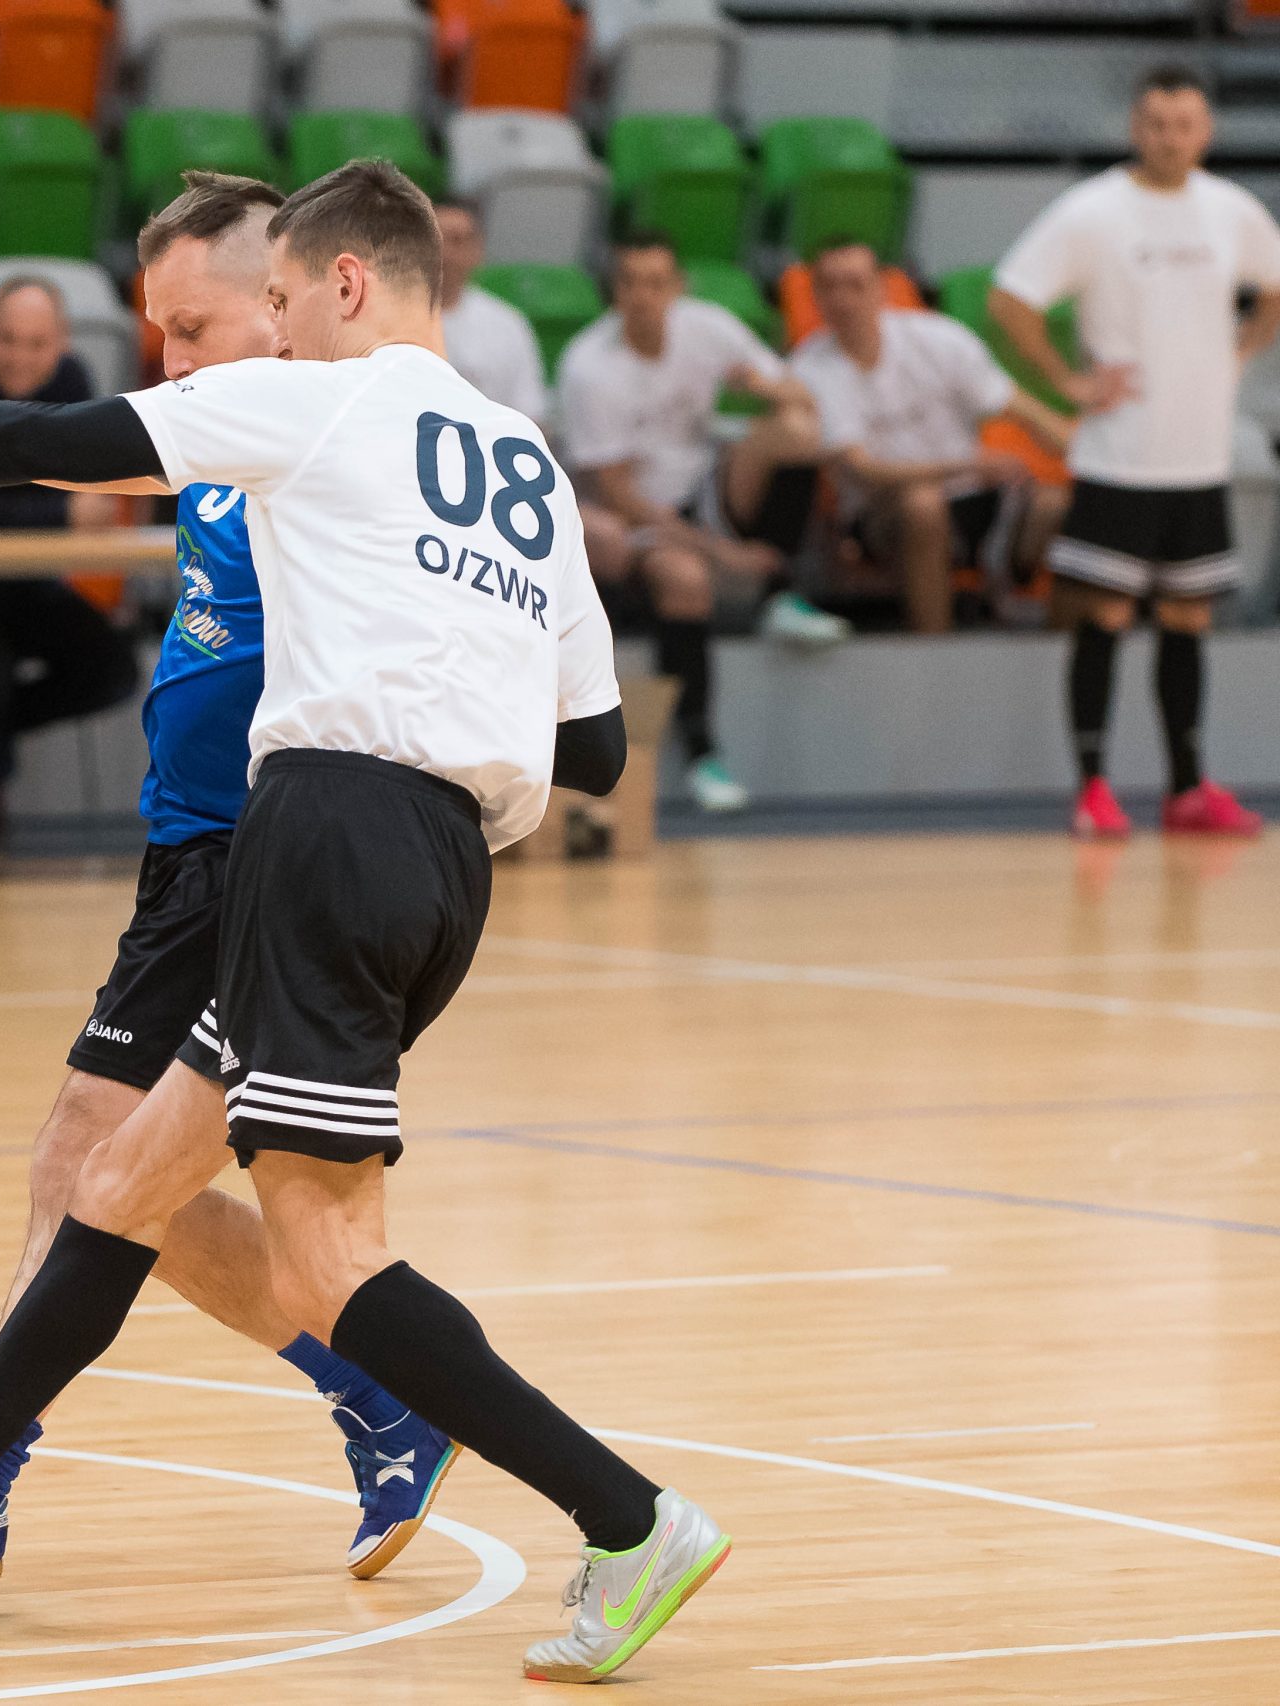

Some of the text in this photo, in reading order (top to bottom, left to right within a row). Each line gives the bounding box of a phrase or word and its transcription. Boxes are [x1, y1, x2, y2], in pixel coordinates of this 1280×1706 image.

[416, 411, 556, 561] 08
[415, 534, 548, 632] O/ZWR
[94, 1023, 133, 1044] JAKO
